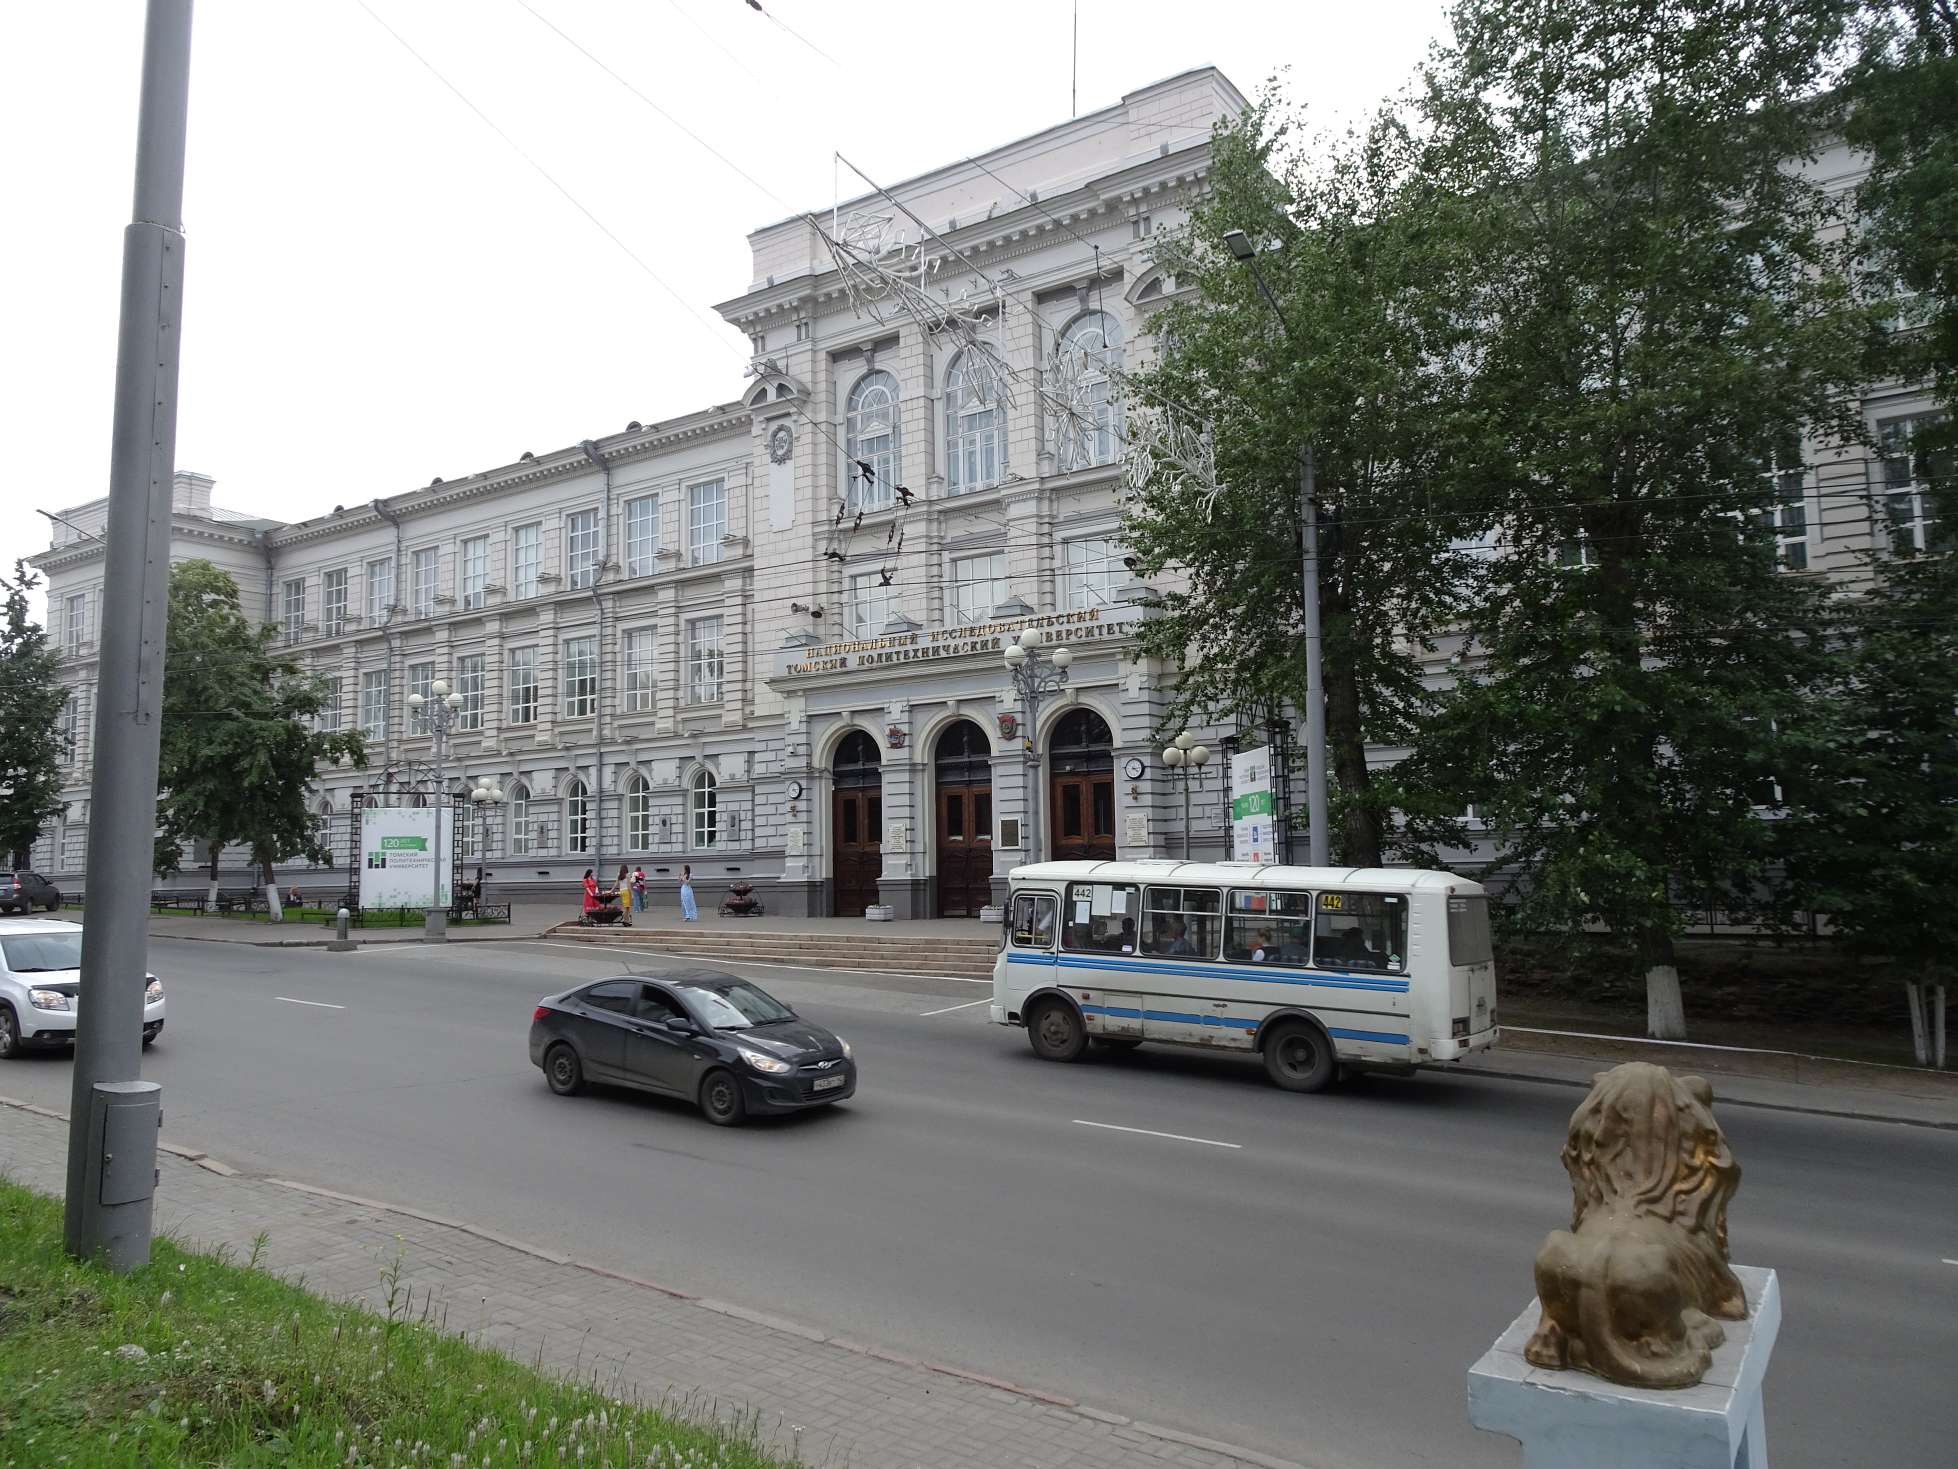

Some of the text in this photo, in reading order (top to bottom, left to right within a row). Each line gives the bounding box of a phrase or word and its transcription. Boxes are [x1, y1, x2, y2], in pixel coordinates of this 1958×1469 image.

[806, 608, 1099, 659] НАЦИОНАЛЬНЫЙ ИССЛЕДОВАТЕЛЬСКИЙ
[786, 622, 1126, 675] ТОМСКИЙ ПОЛИТЕХНИЧЕСКИЙ УВЕРСИТЕТ
[383, 838, 400, 848] 120
[1074, 888, 1091, 898] 442
[1323, 895, 1341, 909] 442
